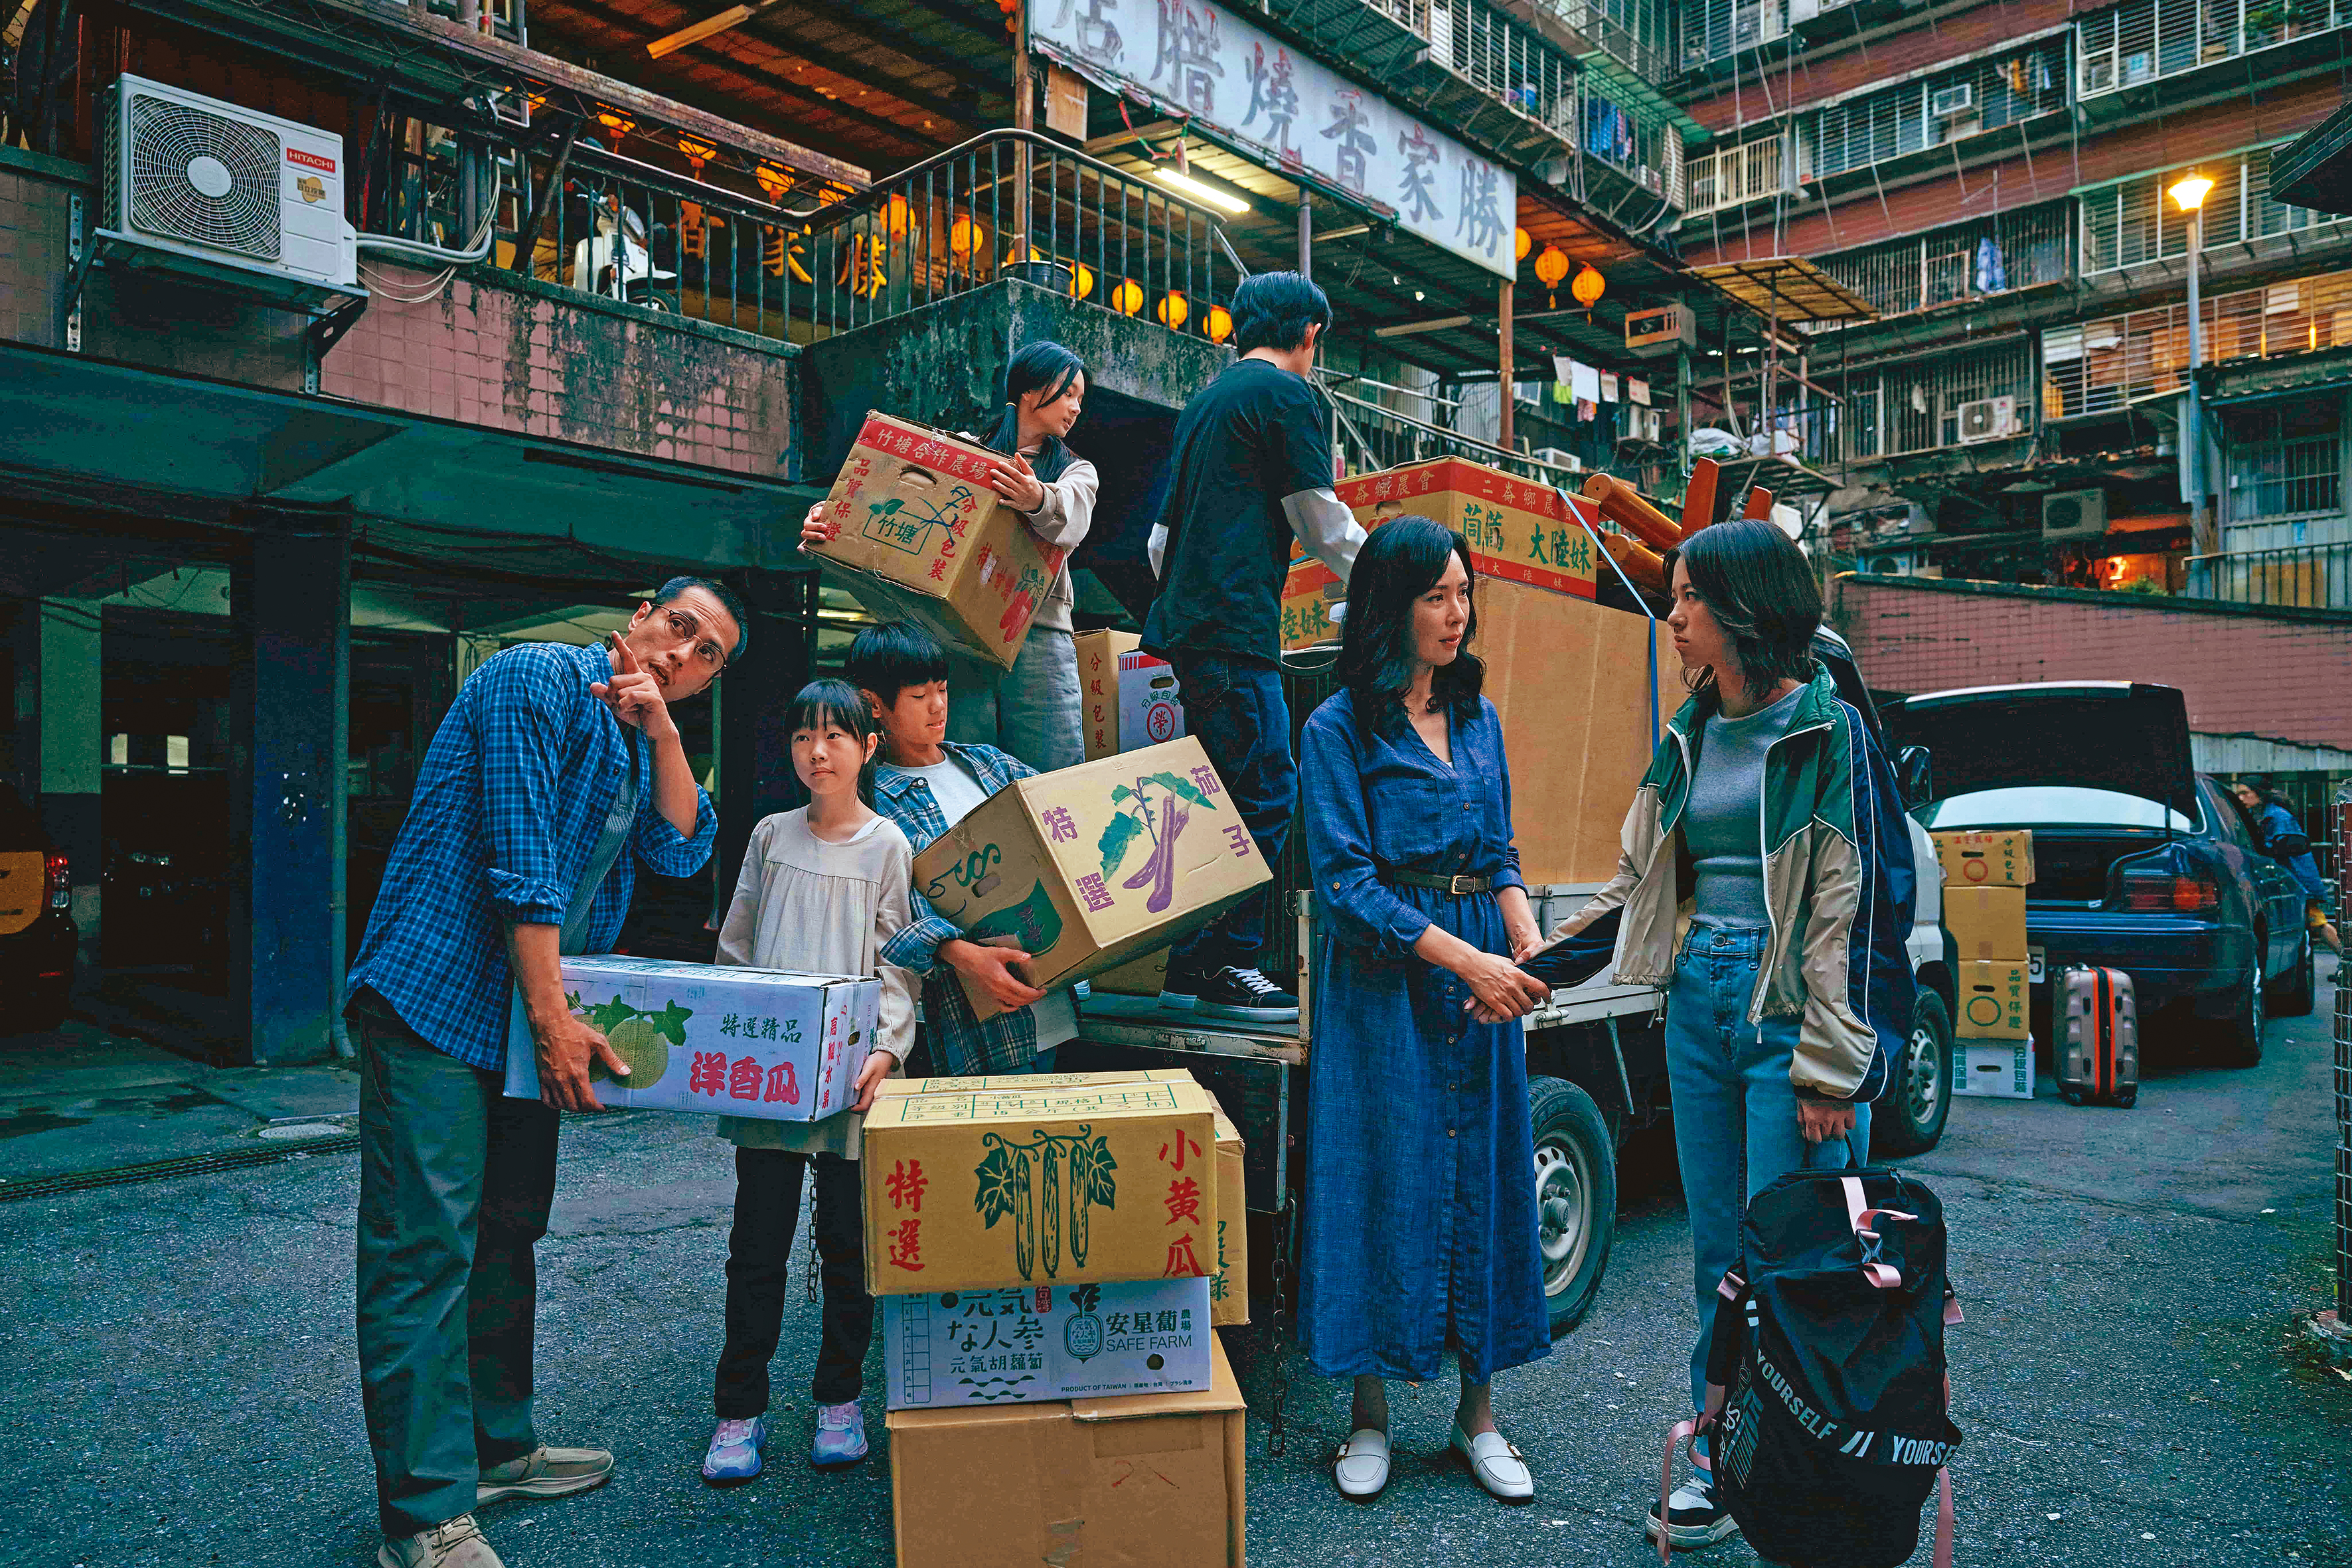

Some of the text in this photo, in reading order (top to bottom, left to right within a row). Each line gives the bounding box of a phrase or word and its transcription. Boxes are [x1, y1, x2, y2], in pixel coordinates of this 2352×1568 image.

[289, 151, 333, 169] HITACHI
[877, 428, 987, 479] 竹塘合作農場
[878, 514, 917, 544] 竹塘
[927, 495, 978, 581] 分級包裝
[1529, 523, 1592, 576] 大陸妹
[1089, 653, 1107, 749] 分級包裝
[1190, 765, 1251, 858] 茄子
[1042, 806, 1115, 913] 特選
[720, 1013, 802, 1044] 特選精品
[690, 1051, 801, 1105] 洋香瓜
[886, 1159, 929, 1272] 特選
[1159, 1129, 1204, 1277] 小黃瓜
[963, 1288, 1032, 1316] 元気
[1106, 1310, 1178, 1336] 安星蔔
[1180, 1309, 1192, 1331] 農場
[947, 1315, 1044, 1352] な人参
[1107, 1334, 1192, 1352] SAFE FARM
[951, 1352, 1044, 1373] 元氣胡蘿蔔
[1755, 1348, 1838, 1440] YOURSELF
